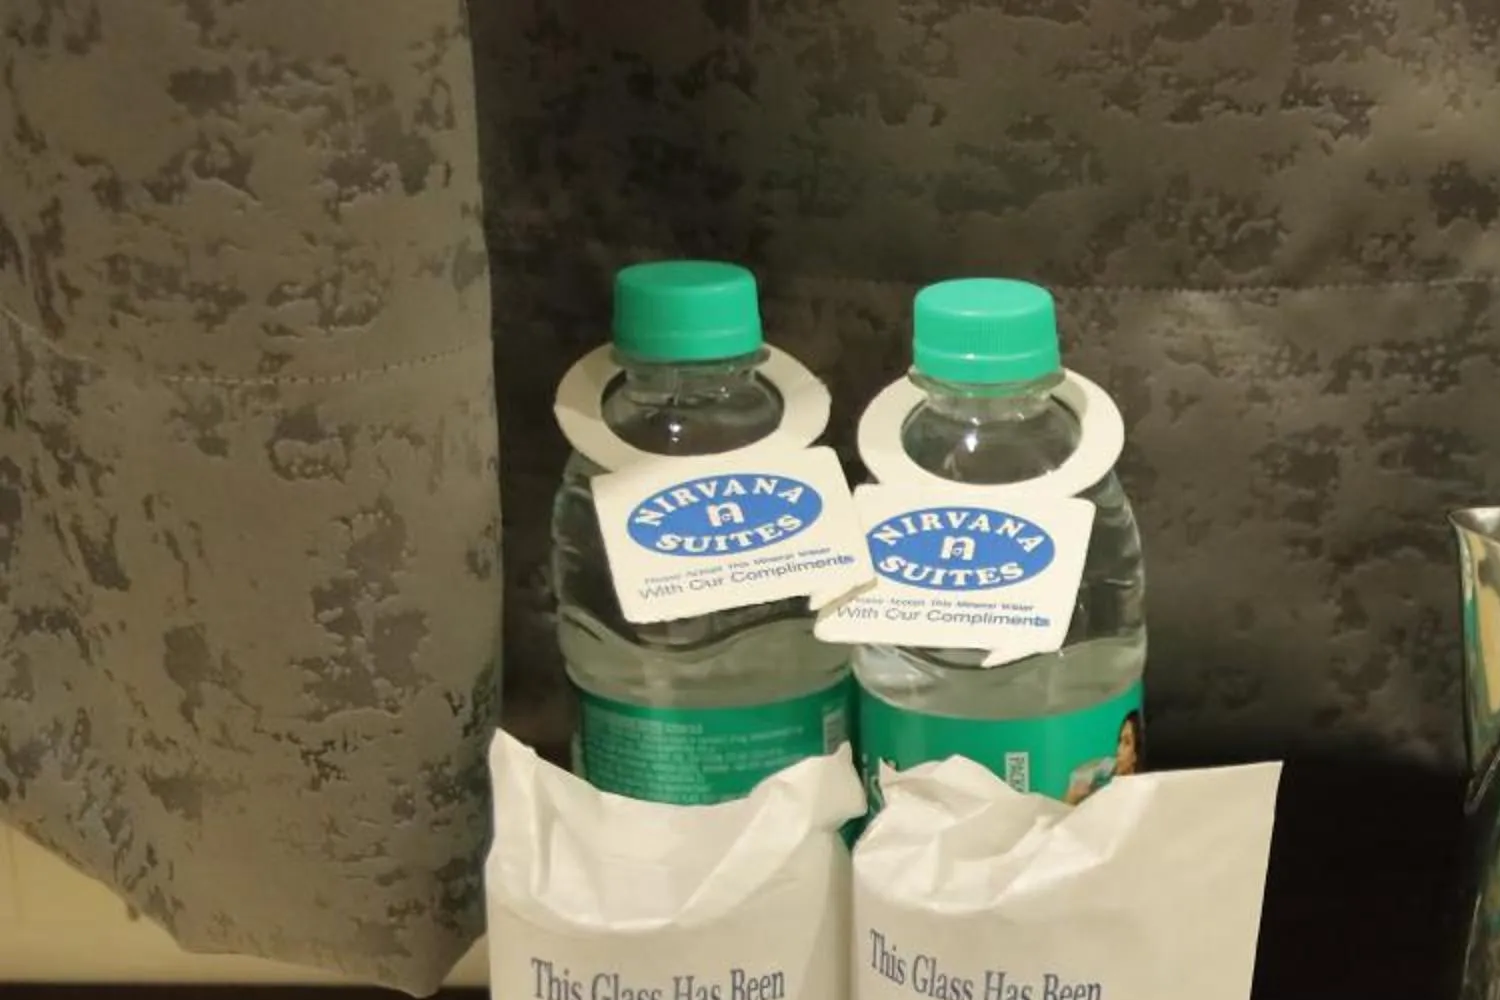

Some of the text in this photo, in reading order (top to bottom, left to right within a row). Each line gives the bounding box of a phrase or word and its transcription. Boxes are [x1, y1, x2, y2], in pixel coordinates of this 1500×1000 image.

[634, 478, 804, 528] NIRVANA
[656, 514, 803, 553] SUITES
[872, 511, 1045, 553] NIRVANA
[639, 554, 855, 600] With Our Compliments
[878, 555, 1024, 586] SUITES
[836, 607, 1050, 629] With Our Compliments
[870, 928, 906, 985] This
